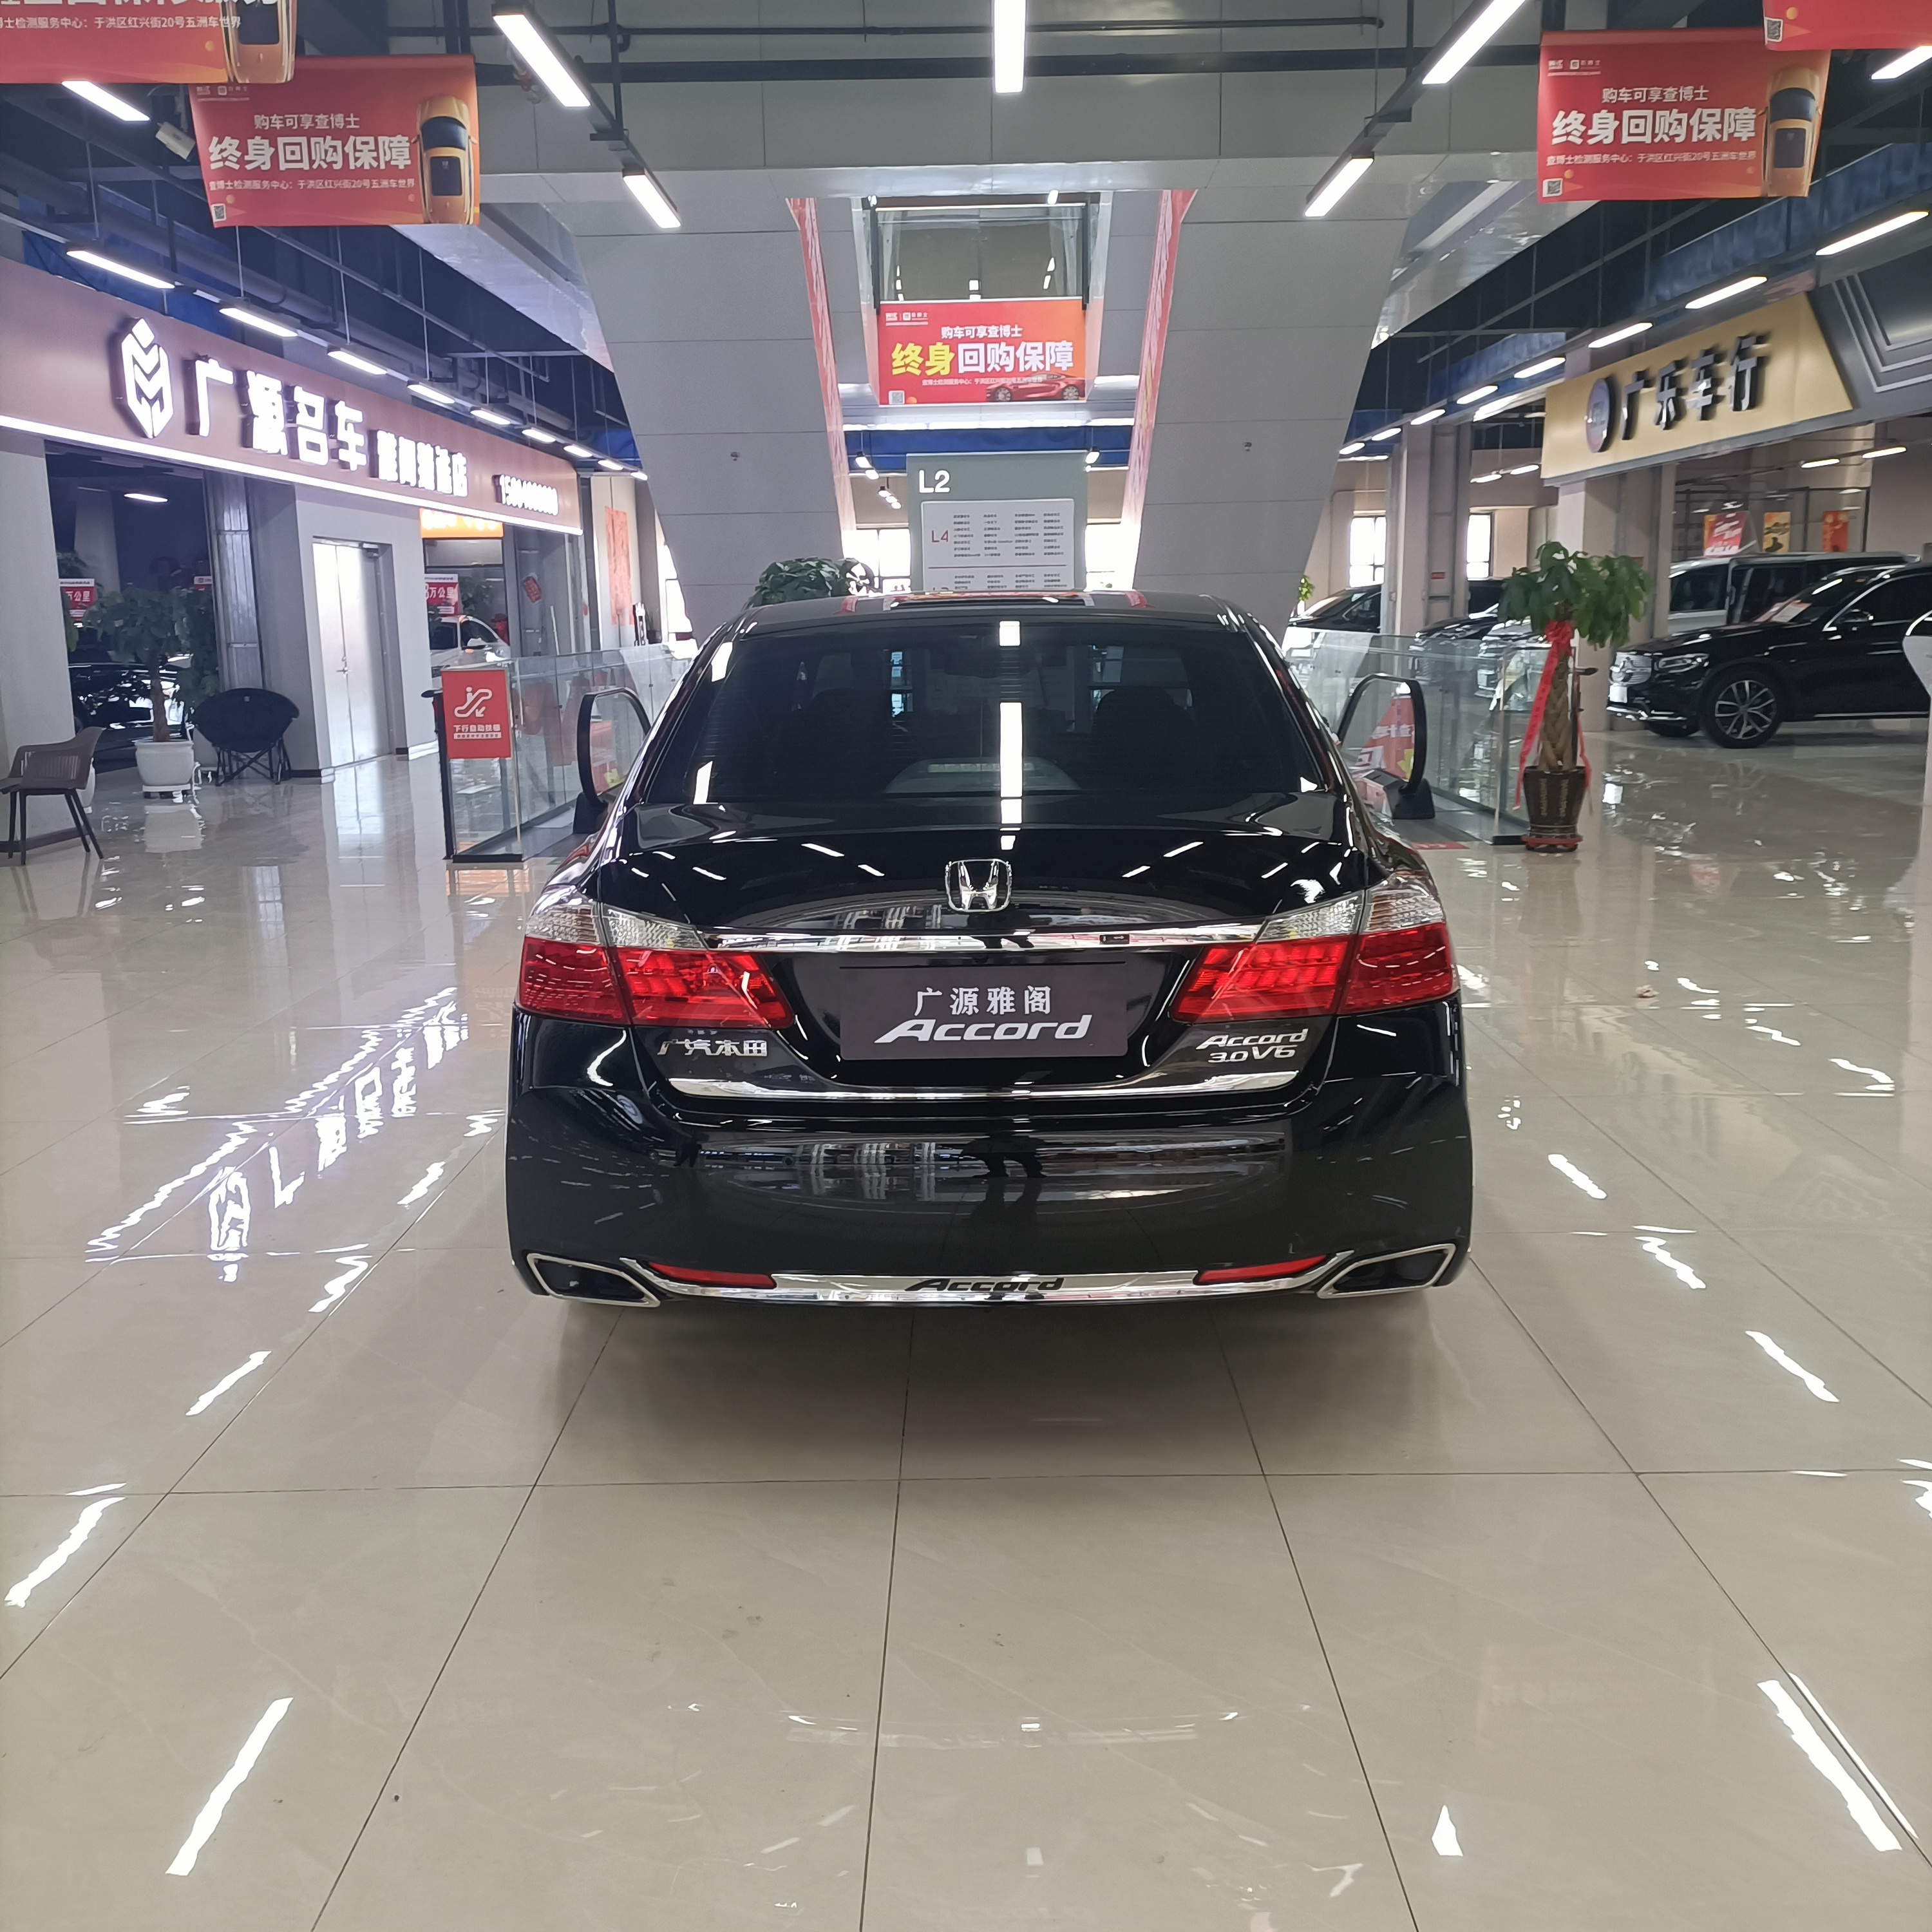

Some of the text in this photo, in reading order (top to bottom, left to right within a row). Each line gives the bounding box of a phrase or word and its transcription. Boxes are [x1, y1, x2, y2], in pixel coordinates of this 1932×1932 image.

[1602, 86, 1709, 103] 购车可享查博士
[254, 113, 360, 129] 购车可享查博士
[1551, 106, 1756, 145] 终身回购保障
[208, 135, 412, 171] 终身回购保障
[941, 324, 1023, 339] 购车可享查博士
[891, 340, 1074, 376] 终身回购保障
[918, 469, 951, 493] L2
[931, 530, 949, 542] L4
[914, 985, 1052, 1016] 广源雅阁
[874, 1014, 1093, 1043] Accord
[1195, 1028, 1309, 1050] Accord
[657, 1039, 768, 1057] 广汽本田
[904, 1277, 1065, 1292] Accord
